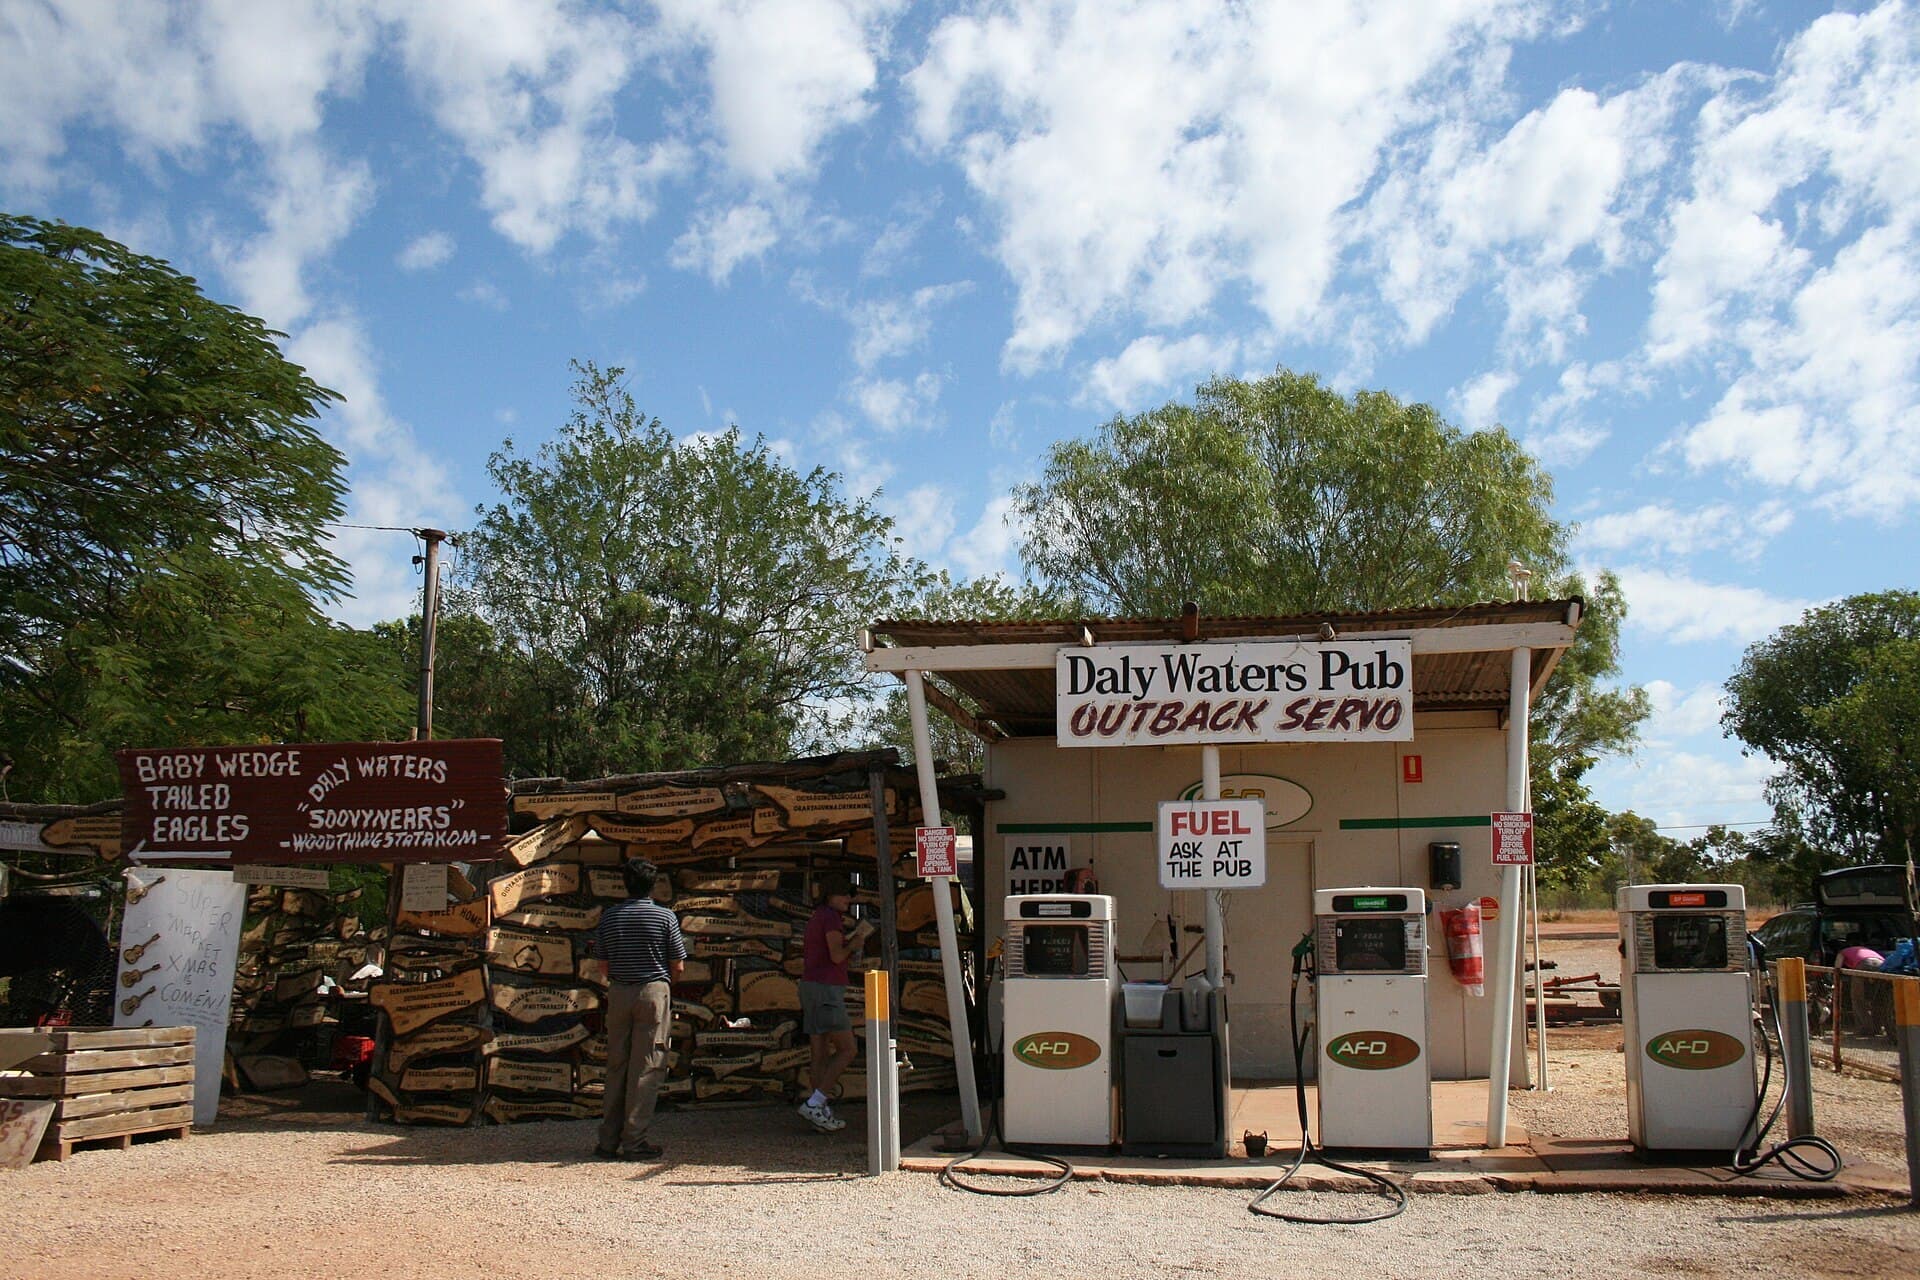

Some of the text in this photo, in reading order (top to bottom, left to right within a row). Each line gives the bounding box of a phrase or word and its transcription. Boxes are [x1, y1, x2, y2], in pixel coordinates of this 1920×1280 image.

[1067, 650, 1404, 701] Daly Waters Pub
[1070, 696, 1403, 736] OUTBACK SERVO
[136, 750, 301, 783] BABY WEDGE
[308, 754, 449, 803] DALY WATERS
[145, 783, 231, 810] TAILED
[153, 814, 249, 843] EAGLES
[1171, 810, 1251, 836] FUEL
[1010, 847, 1066, 870] ATM
[1169, 841, 1243, 858] ASK AT
[1166, 860, 1252, 878] THE PUB
[1022, 1041, 1069, 1055] AFD
[1336, 1041, 1387, 1055] AFD
[1657, 1040, 1709, 1054] AFD
